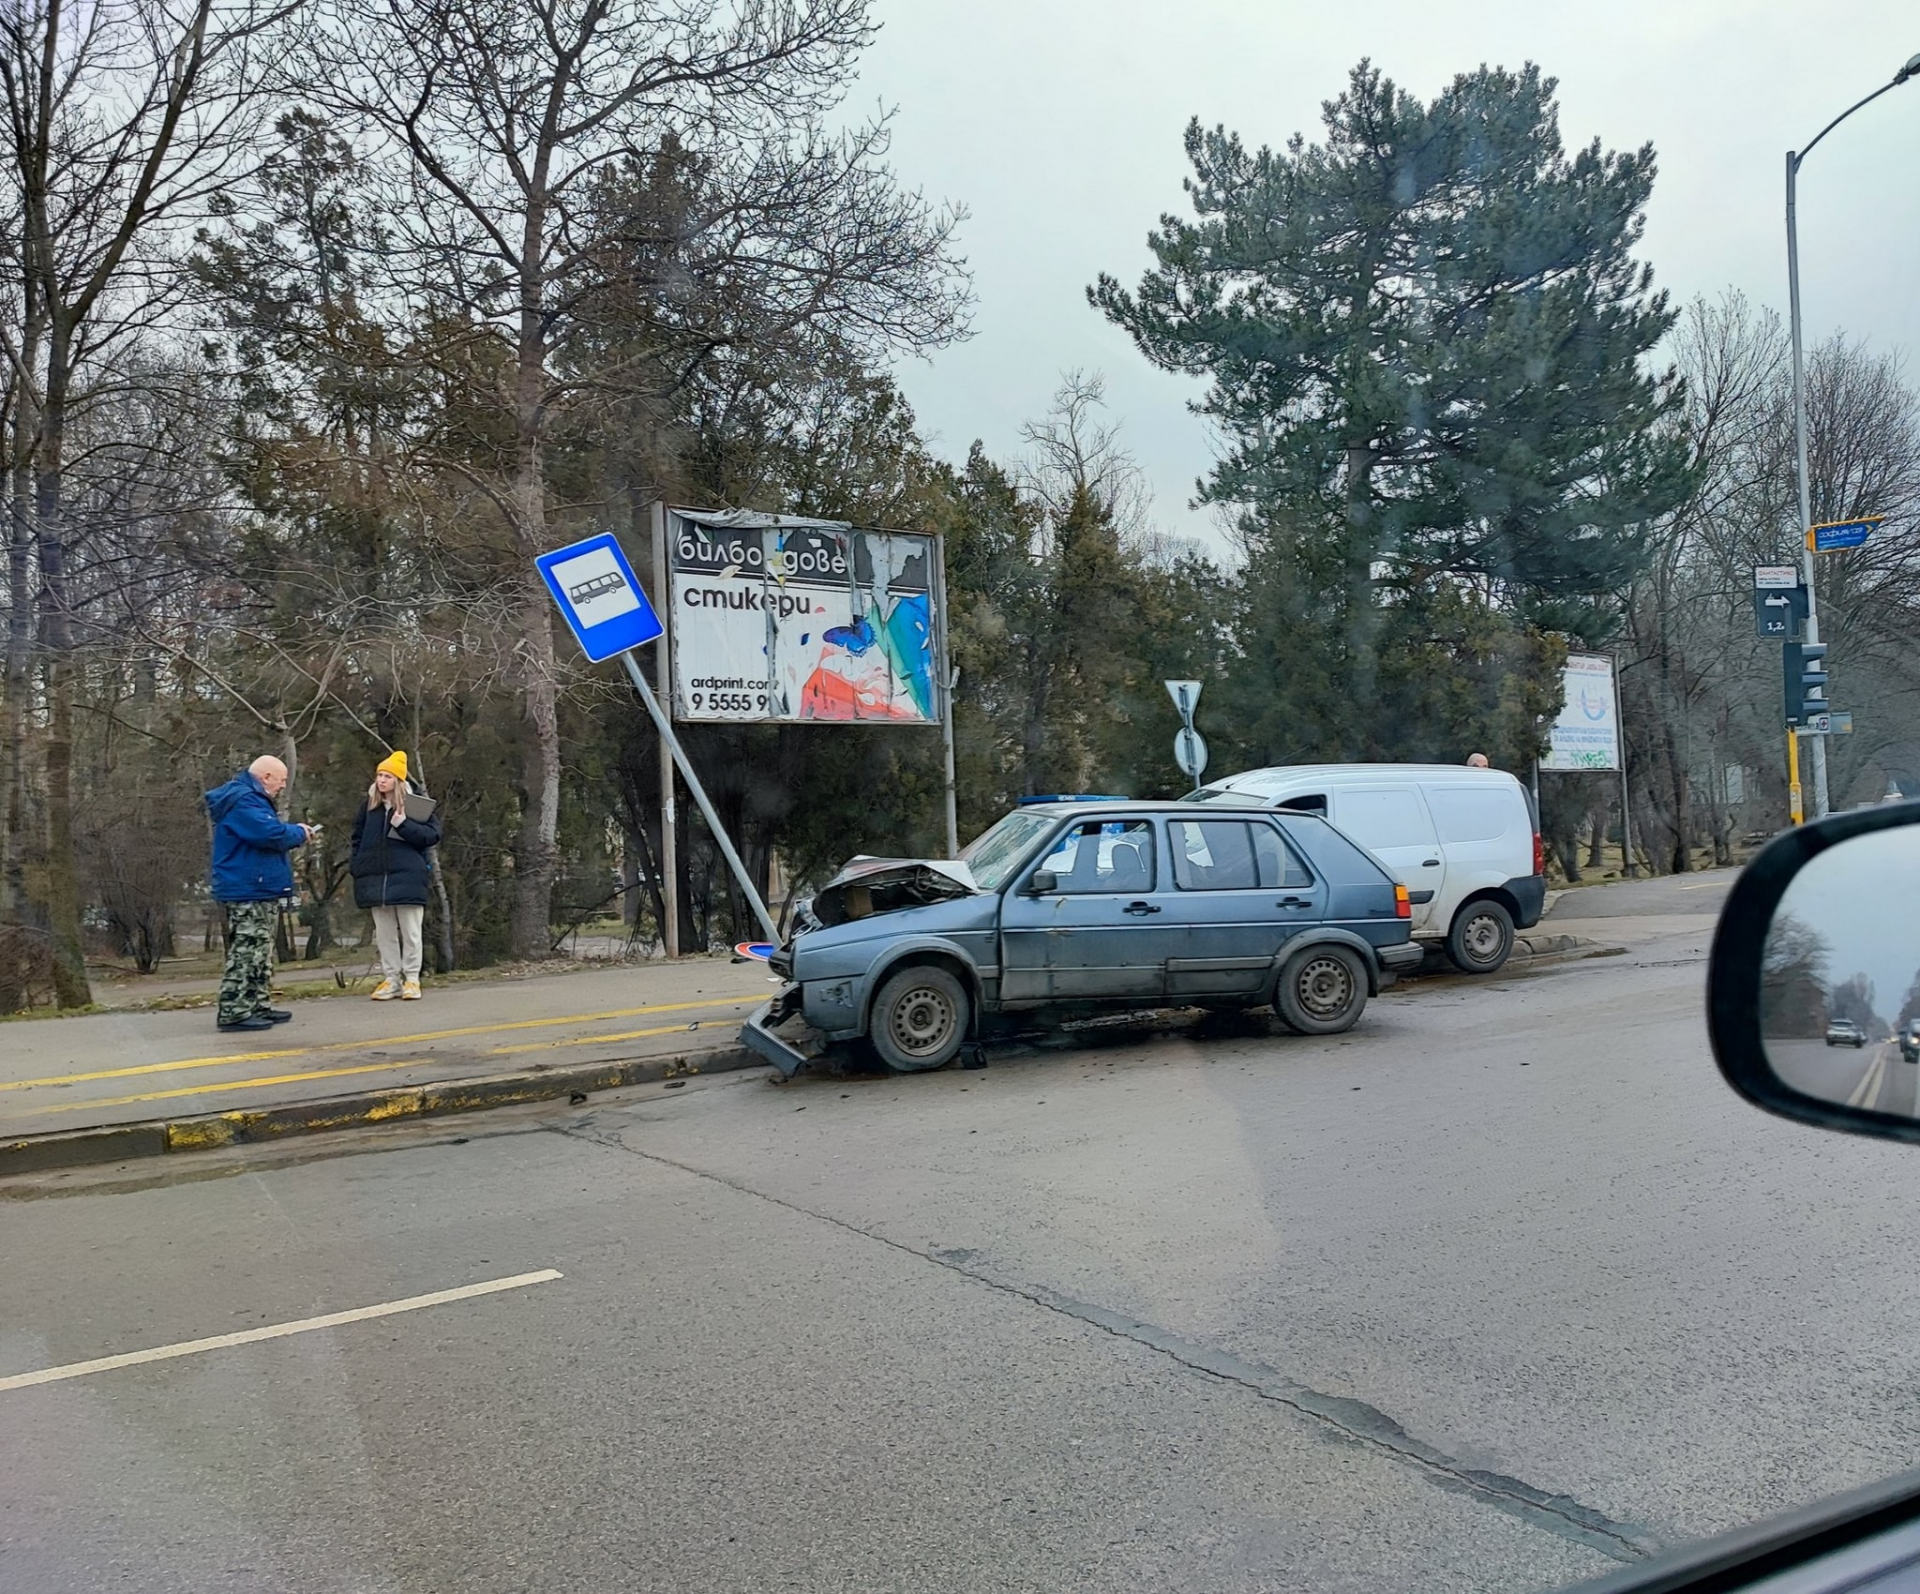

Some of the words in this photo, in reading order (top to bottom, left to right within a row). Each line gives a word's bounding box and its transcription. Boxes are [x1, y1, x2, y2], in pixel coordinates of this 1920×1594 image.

[678, 535, 847, 576] билбодове
[691, 692, 703, 710] 9
[708, 693, 751, 711] 5555
